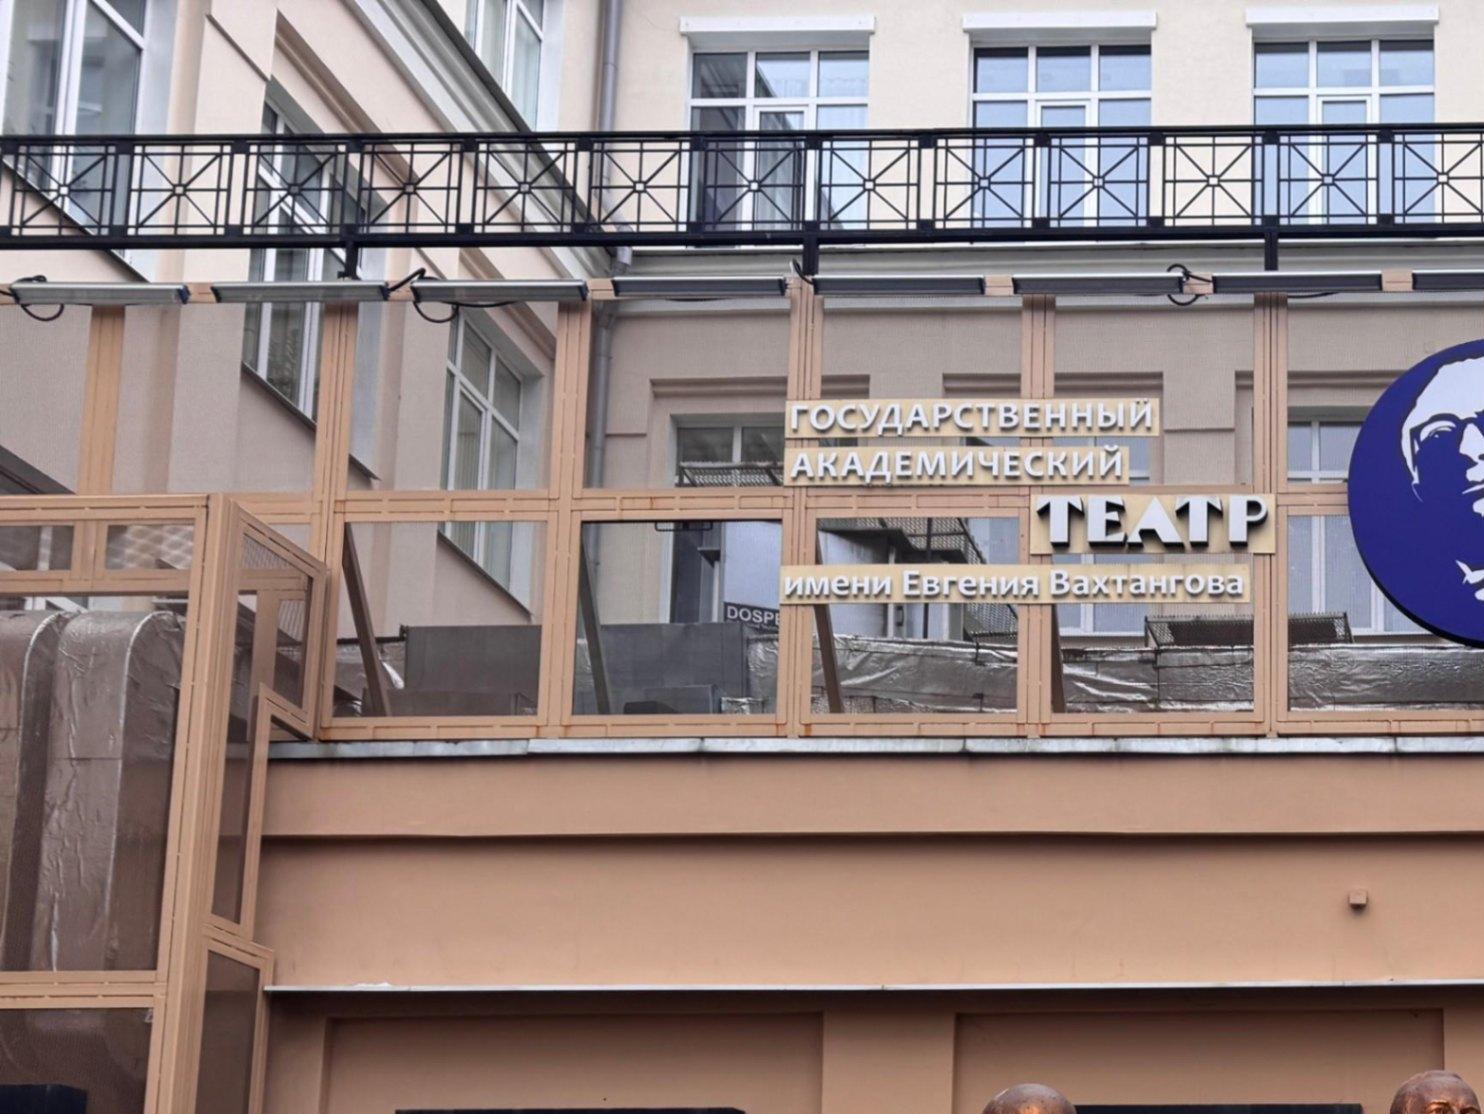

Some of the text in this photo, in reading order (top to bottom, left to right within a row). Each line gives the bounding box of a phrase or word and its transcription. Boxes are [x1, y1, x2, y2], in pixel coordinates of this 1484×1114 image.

[789, 399, 1154, 436] ГОСУДАРСТВЕННЫЙ
[790, 445, 1124, 482] АКАДЕМИЧЕСКИЙ
[1037, 494, 1269, 548] ТЕАТР
[784, 569, 1245, 597] имени Евгения Вахтангова
